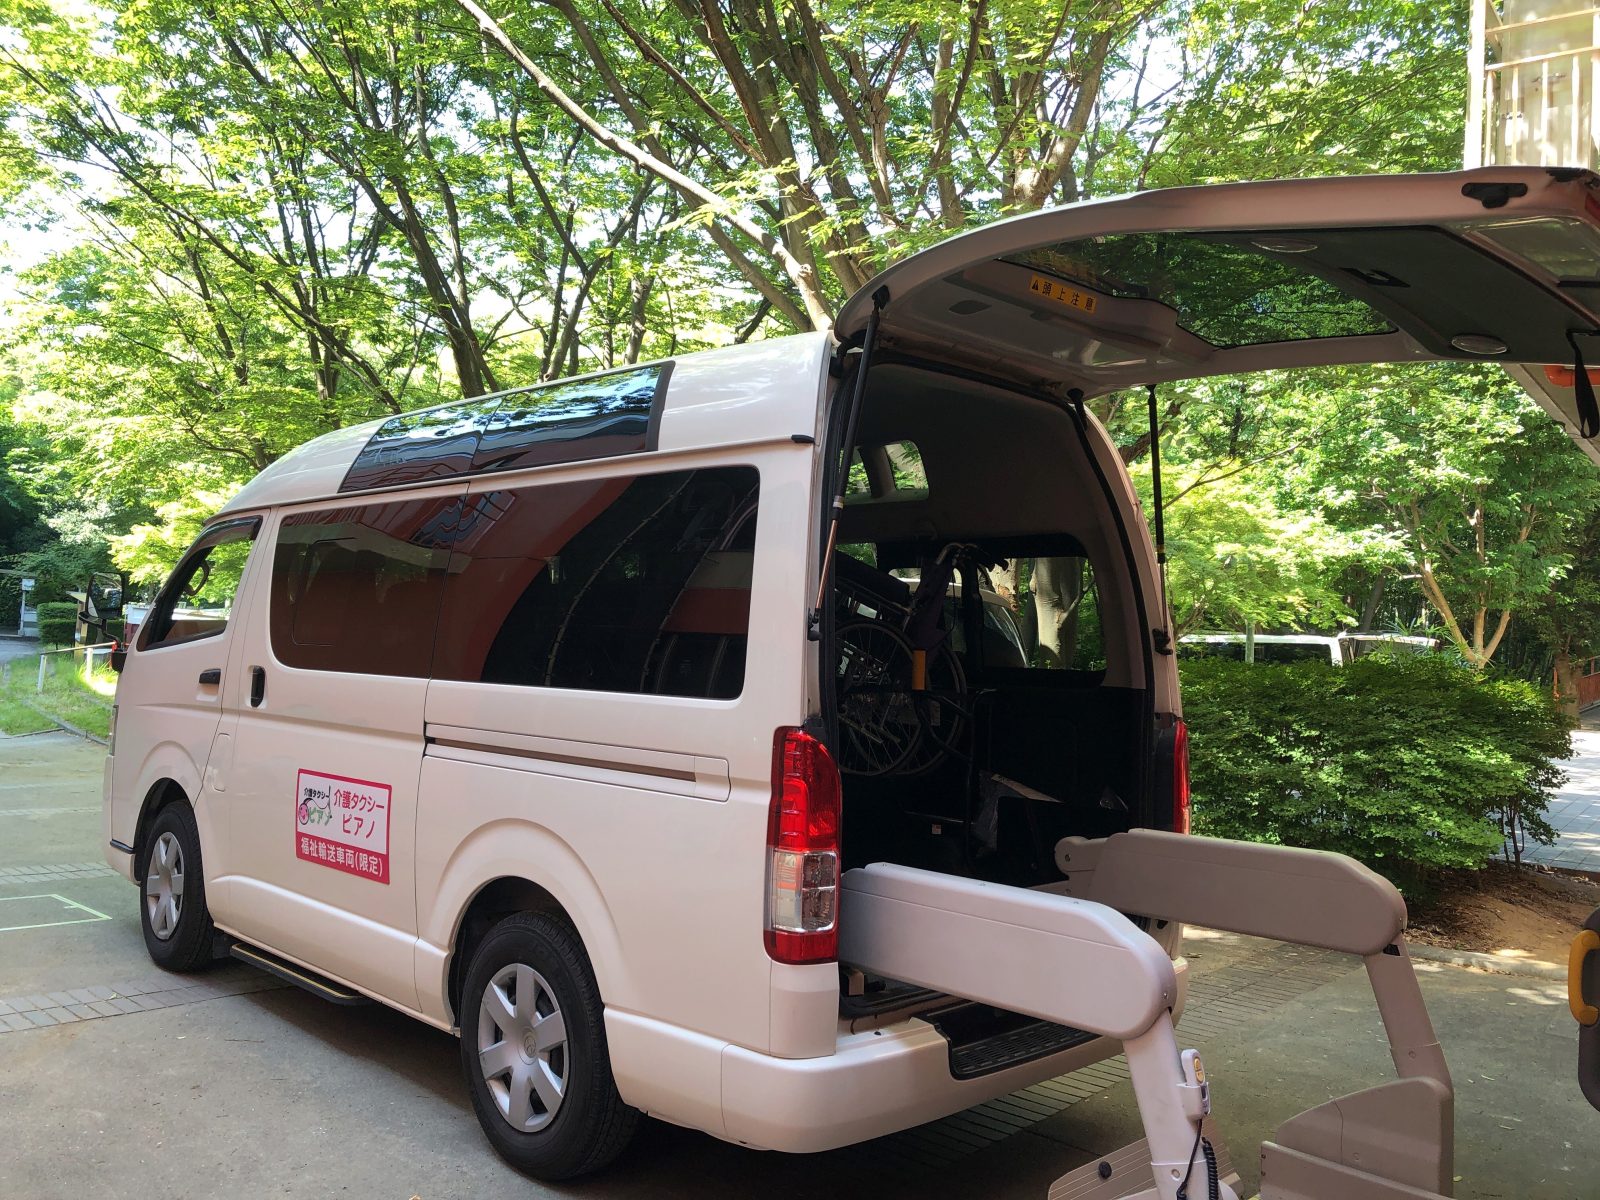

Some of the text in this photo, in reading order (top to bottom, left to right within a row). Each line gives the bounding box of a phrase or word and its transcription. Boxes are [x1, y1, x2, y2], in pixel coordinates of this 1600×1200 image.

[1042, 281, 1096, 311] 頭上注意
[304, 787, 329, 798] 介護タクシー
[334, 789, 384, 813] 介護タクシー
[342, 814, 375, 839] ピアノ
[301, 837, 382, 877] 福祉輸送車両(限定)
